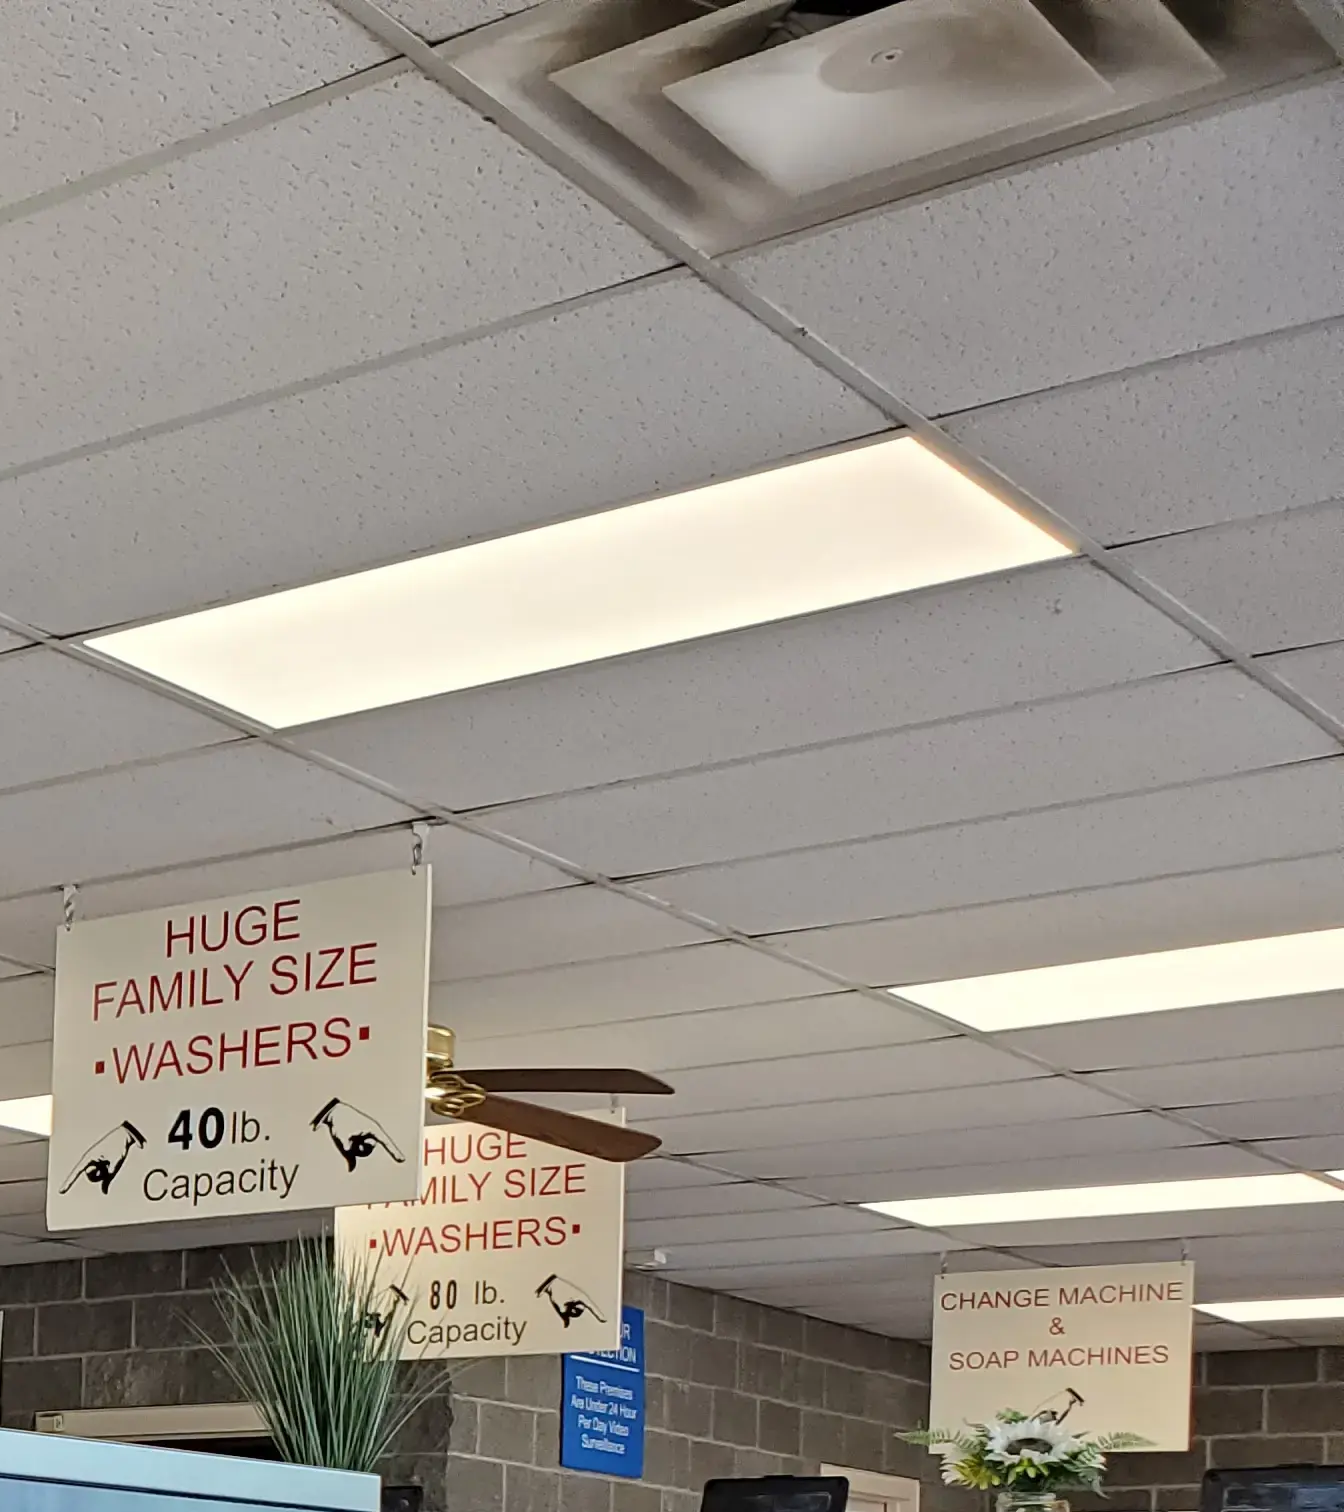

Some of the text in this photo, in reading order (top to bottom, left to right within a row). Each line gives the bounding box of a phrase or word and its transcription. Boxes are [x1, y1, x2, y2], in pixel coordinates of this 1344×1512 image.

[167, 900, 301, 958] HUGE
[93, 942, 378, 1021] FAMILY SIZE
[168, 1107, 270, 1151] 40 lb.
[424, 1131, 527, 1166] HUGE
[143, 1160, 300, 1206] Capacity
[367, 1164, 586, 1210] MILY SIZE
[430, 1280, 505, 1310] 80 lb.
[940, 1282, 1184, 1310] CHANGE MACHINE
[407, 1316, 527, 1347] Capacity
[1049, 1317, 1065, 1335] &
[949, 1345, 1169, 1370] SOAP MACHINES
[585, 1397, 608, 1414] Under
[608, 1402, 618, 1415] 24
[619, 1404, 637, 1419] Hour
[592, 1418, 608, 1434] Day
[609, 1421, 629, 1436] Video
